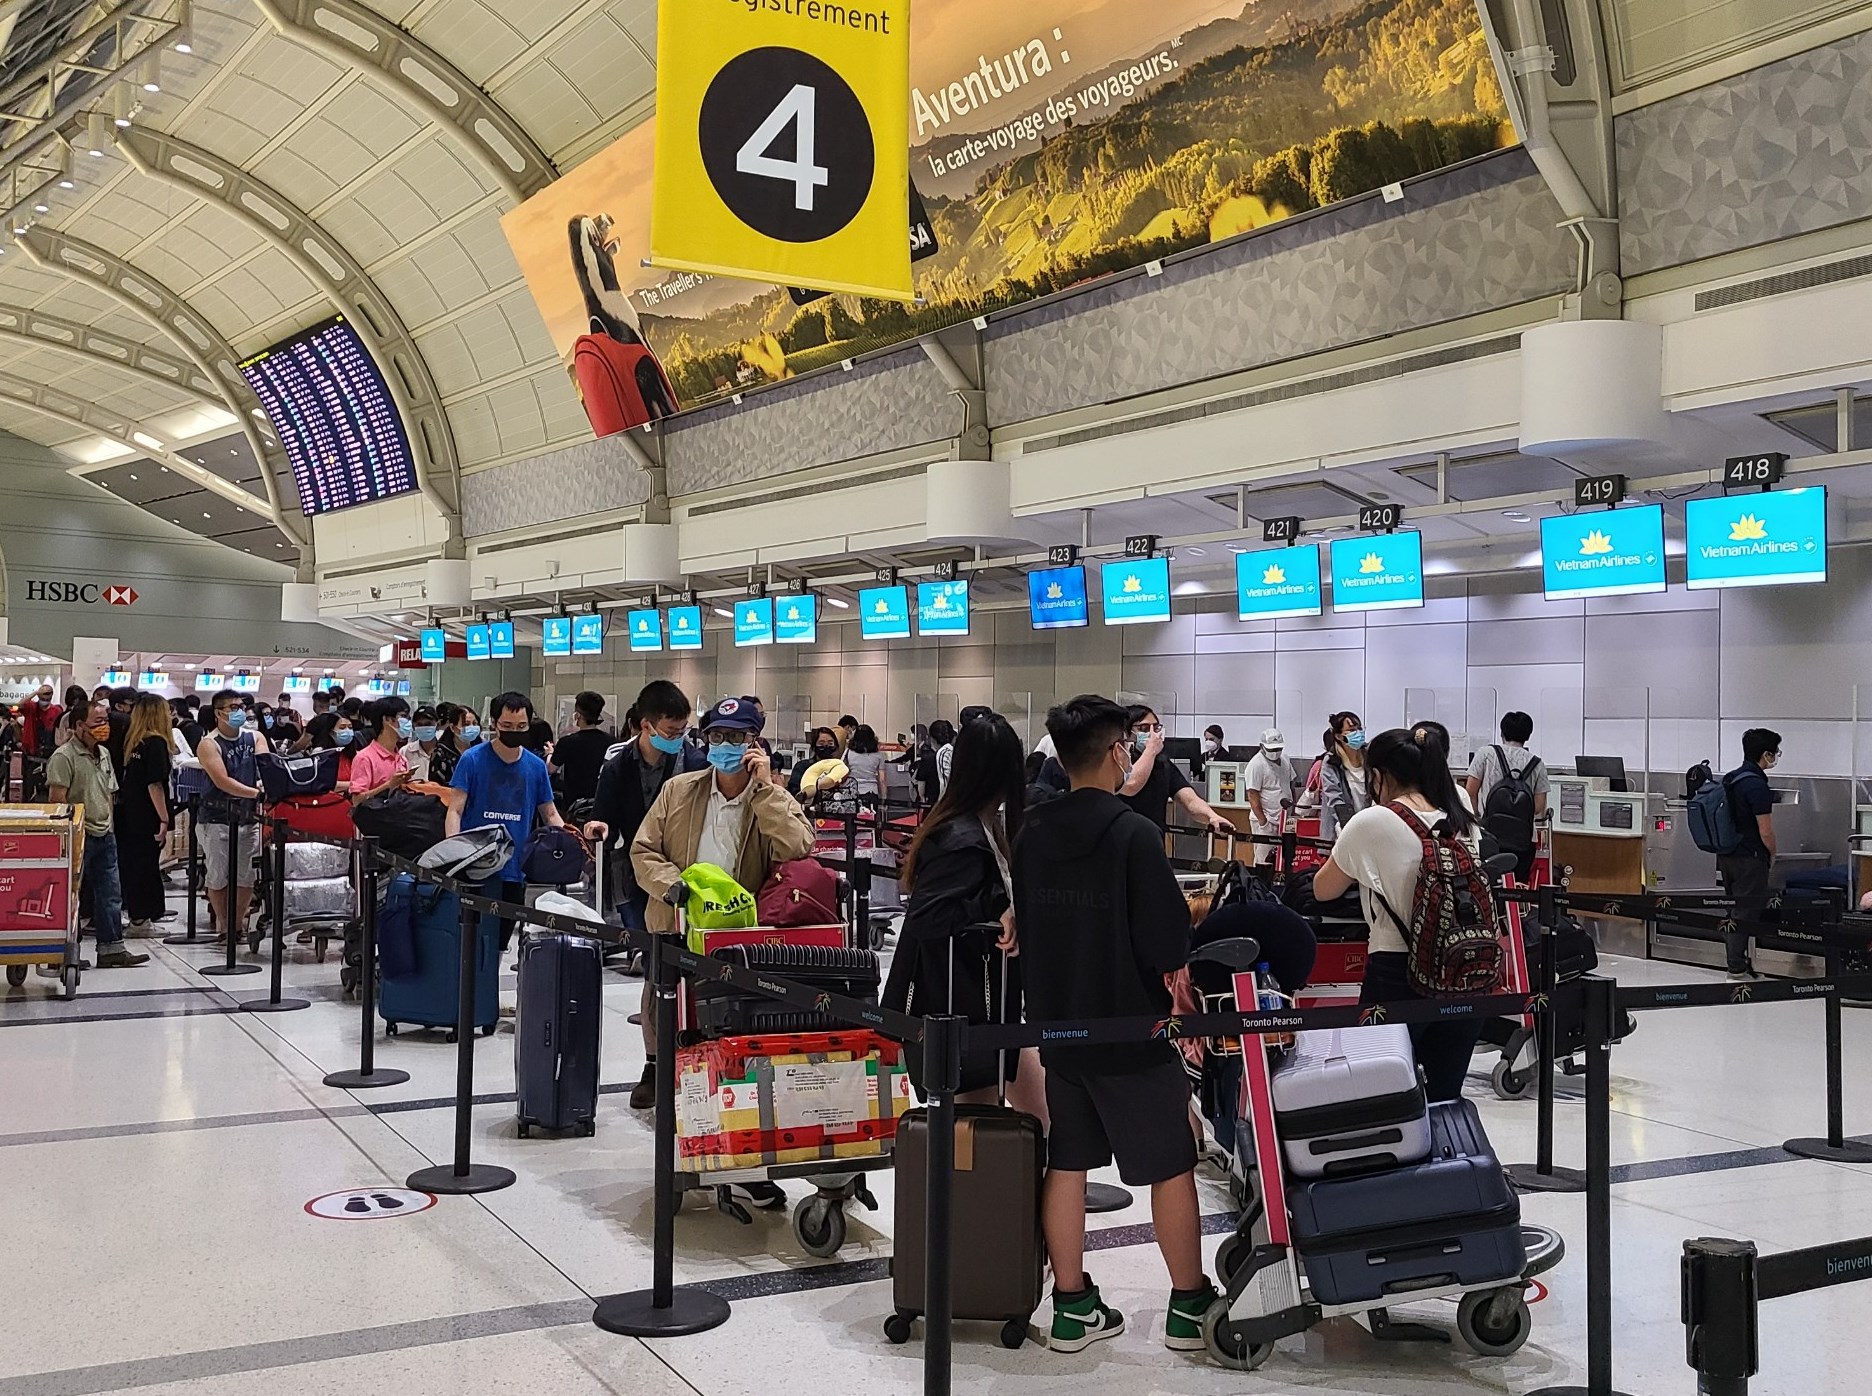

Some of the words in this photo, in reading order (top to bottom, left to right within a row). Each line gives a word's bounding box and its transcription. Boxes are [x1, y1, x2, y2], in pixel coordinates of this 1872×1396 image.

[910, 38, 1052, 136] Aventura
[927, 154, 945, 178] la
[946, 110, 1044, 171] carte-voyage
[1044, 97, 1077, 126] des
[1077, 51, 1179, 107] voyageurs.
[735, 83, 829, 211] 4
[639, 288, 659, 308] The
[1730, 458, 1769, 481] 418
[1580, 479, 1613, 500] 419
[1361, 508, 1392, 526] 420
[1267, 520, 1290, 537] 421
[1127, 538, 1148, 554] 422
[1050, 548, 1070, 562] 423
[877, 569, 890, 581] 425
[935, 563, 951, 575] 424
[25, 580, 99, 603] HSBC
[748, 583, 759, 594] 427
[789, 578, 800, 590] 426
[484, 811, 521, 821] CONVERSE
[0, 876, 15, 884] art
[1777, 929, 1799, 939] Toronto
[1800, 931, 1823, 942] Pearson
[757, 978, 771, 990] Toronto
[771, 982, 787, 994] Pearson
[1793, 984, 1813, 993] Toronto
[1814, 983, 1835, 992] Pearson
[1655, 991, 1688, 1000] bienvenue
[1440, 1004, 1473, 1014] welcome
[861, 1009, 884, 1025] welcome
[1242, 1017, 1271, 1028] Toronto
[1272, 1016, 1303, 1027] Pearson
[1042, 1029, 1089, 1040] bienvenue
[1827, 1255, 1872, 1275] bienven
